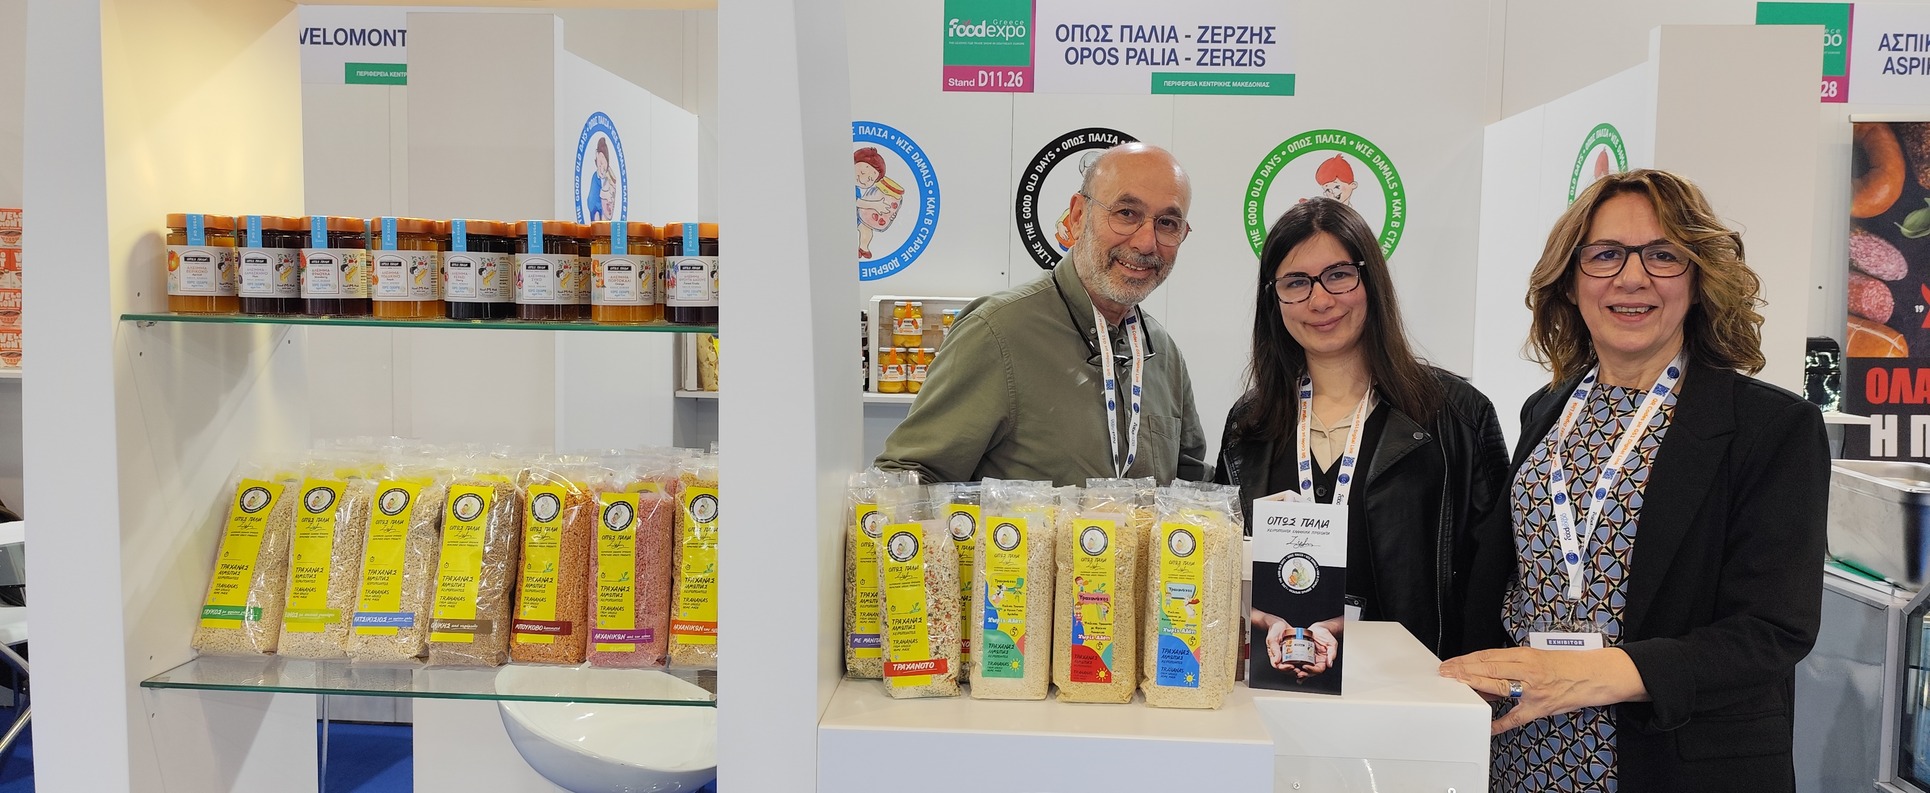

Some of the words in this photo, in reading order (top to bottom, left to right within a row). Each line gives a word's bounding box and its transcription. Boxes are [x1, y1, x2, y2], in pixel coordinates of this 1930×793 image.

[949, 19, 1026, 41] foodexpo
[1056, 24, 1113, 43] ΟΠΩΣ
[1120, 25, 1180, 44] ΠΑΛΙΑ
[1197, 26, 1277, 45] ΖΕΡΖΗΣ
[1065, 47, 1120, 66] OPOS
[1126, 48, 1180, 66] PALIA
[1196, 49, 1266, 68] ZERZIS
[948, 78, 976, 87] Stand
[978, 71, 1024, 88] D11.26
[1164, 80, 1198, 88] ΠΕΡΙΦΕΡΕΙΑ
[858, 126, 889, 139] ΠΑΛΙΑ
[1062, 134, 1086, 151] ΟΠΩΣ
[1089, 133, 1119, 145] ΠΑΛΙΑ
[1288, 136, 1313, 154] ΟΠΩΣ
[1315, 134, 1348, 146] ΠΑΛΙΑ
[896, 137, 913, 155] WIE
[911, 152, 934, 188] DAMALS
[1035, 151, 1056, 174] DAYS
[1260, 154, 1282, 178] DAYS
[1355, 141, 1376, 159] WIE
[1372, 154, 1399, 191] DAMALS
[1025, 174, 1040, 193] OLD
[1251, 180, 1265, 198] OLD
[1022, 194, 1033, 220] GOOD
[1248, 200, 1259, 226] GOOD
[1024, 223, 1036, 241] THE
[1250, 228, 1264, 249] THE
[901, 227, 930, 262] СТАРЫЕ
[1032, 241, 1052, 264] LIKE
[862, 256, 901, 277] ДОБРЫЕ
[1915, 305, 1925, 313] 19
[1870, 415, 1898, 458] Η
[1267, 516, 1296, 527] ΟΠΩΣ
[1301, 518, 1330, 529] ΠΑΛΙΑ
[893, 662, 935, 671] ΤΡΑΧΑΝΟΤΟ
